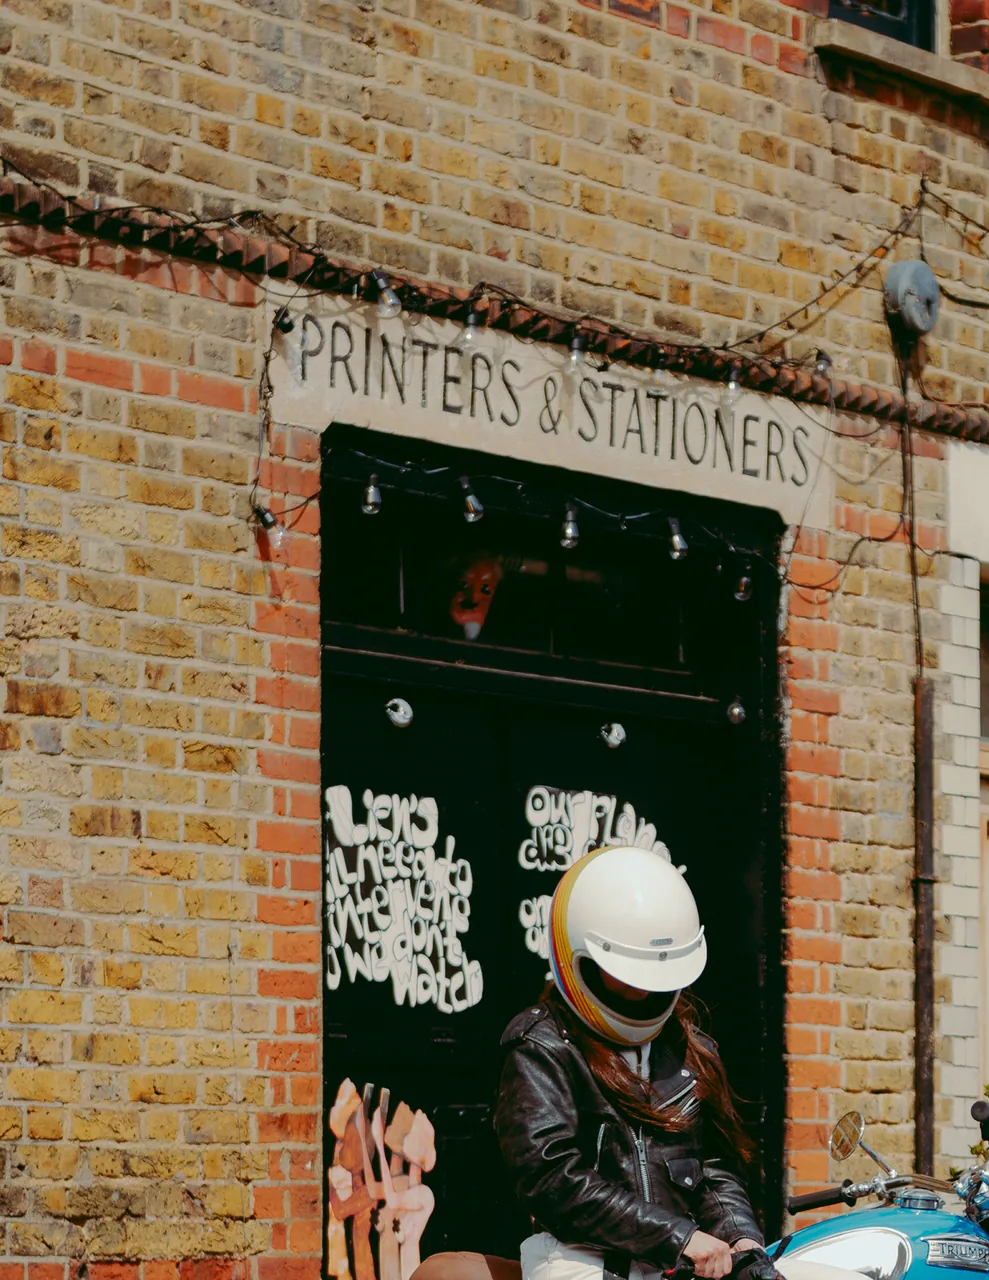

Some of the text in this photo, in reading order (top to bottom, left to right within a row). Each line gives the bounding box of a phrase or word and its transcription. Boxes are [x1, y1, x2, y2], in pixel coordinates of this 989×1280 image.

[299, 313, 815, 487] PRINTERS & STATIONERS
